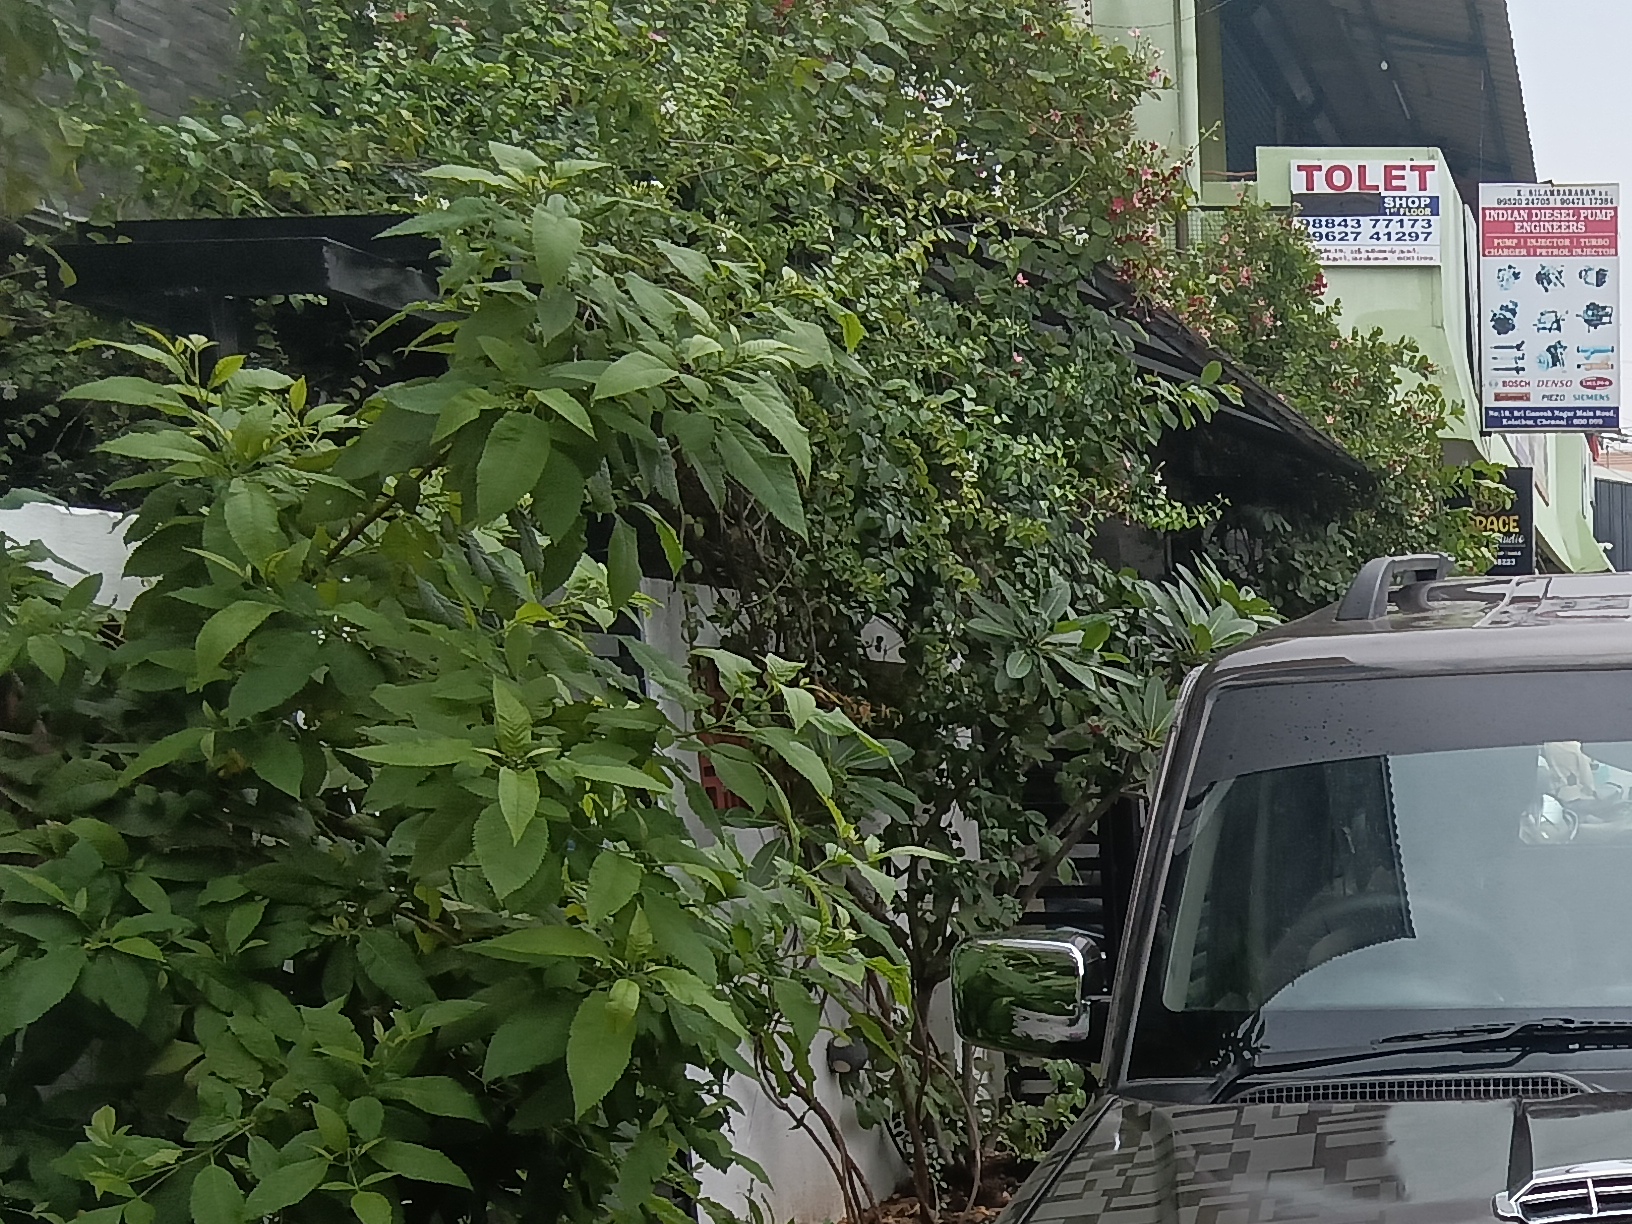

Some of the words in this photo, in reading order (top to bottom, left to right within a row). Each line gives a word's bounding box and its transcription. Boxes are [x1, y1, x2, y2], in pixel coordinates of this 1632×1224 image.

[1296, 164, 1436, 192] TOLET
[1383, 197, 1431, 208] SHOP
[1485, 209, 1529, 221] INDIAN
[1531, 209, 1577, 221] DIESEL
[1579, 209, 1615, 221] PUMP
[1369, 218, 1433, 229] 77173
[1514, 221, 1586, 233] ENGINEERS
[1368, 231, 1433, 242] 41297
[1526, 238, 1571, 246] INJECTOR
[1579, 238, 1610, 246] TURBO
[1484, 248, 1527, 256] CHARGER
[1536, 248, 1571, 256] PETROL
[1501, 380, 1531, 388] BOSCH
[1536, 379, 1573, 388] DENSO
[1572, 394, 1610, 402] SIEMENS
